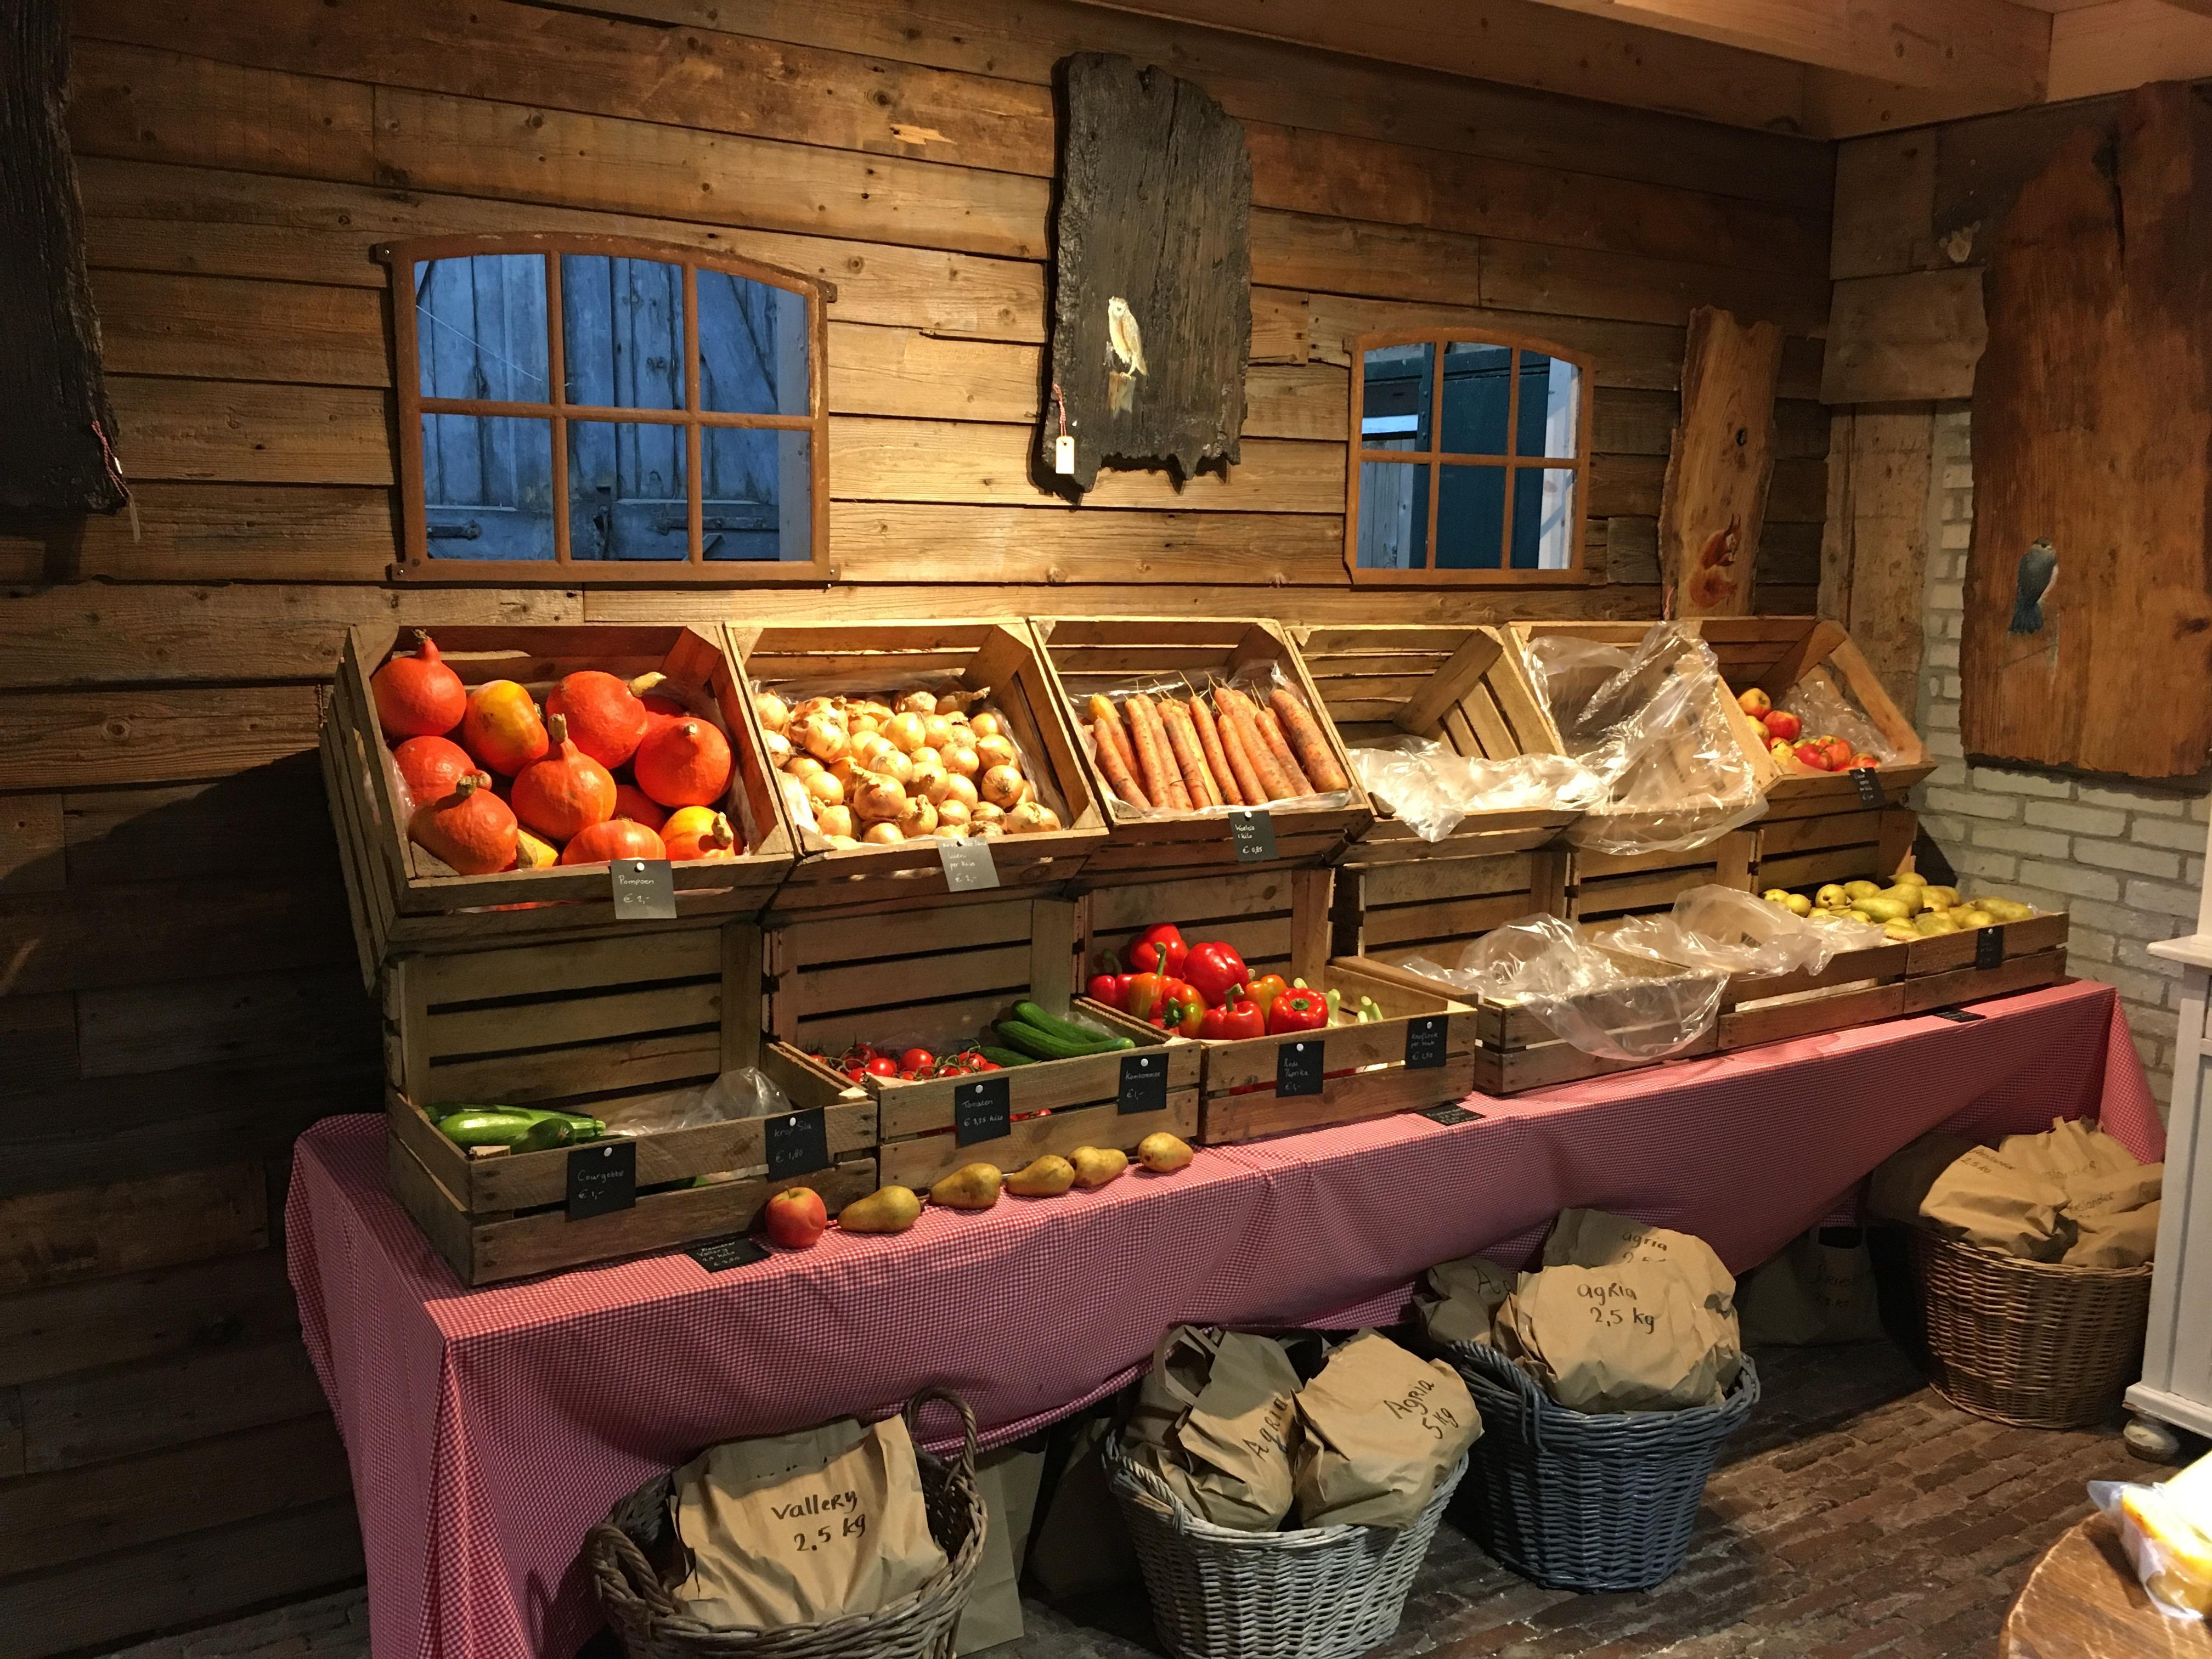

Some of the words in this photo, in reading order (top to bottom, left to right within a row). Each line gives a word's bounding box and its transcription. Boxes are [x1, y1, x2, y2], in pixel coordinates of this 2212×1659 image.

[950, 862, 959, 871] per
[619, 875, 654, 885] Pompoen
[955, 873, 963, 882] €
[623, 893, 633, 902] €
[964, 1118, 970, 1126] €
[776, 1150, 786, 1163] €
[578, 1169, 624, 1183] Courgette
[578, 1188, 588, 1199] €
[1622, 1232, 1667, 1251] agria
[1590, 1307, 1623, 1327] 2,5
[1633, 1307, 1655, 1334] kg
[1422, 1417, 1443, 1440] 5
[843, 1514, 866, 1538] kg
